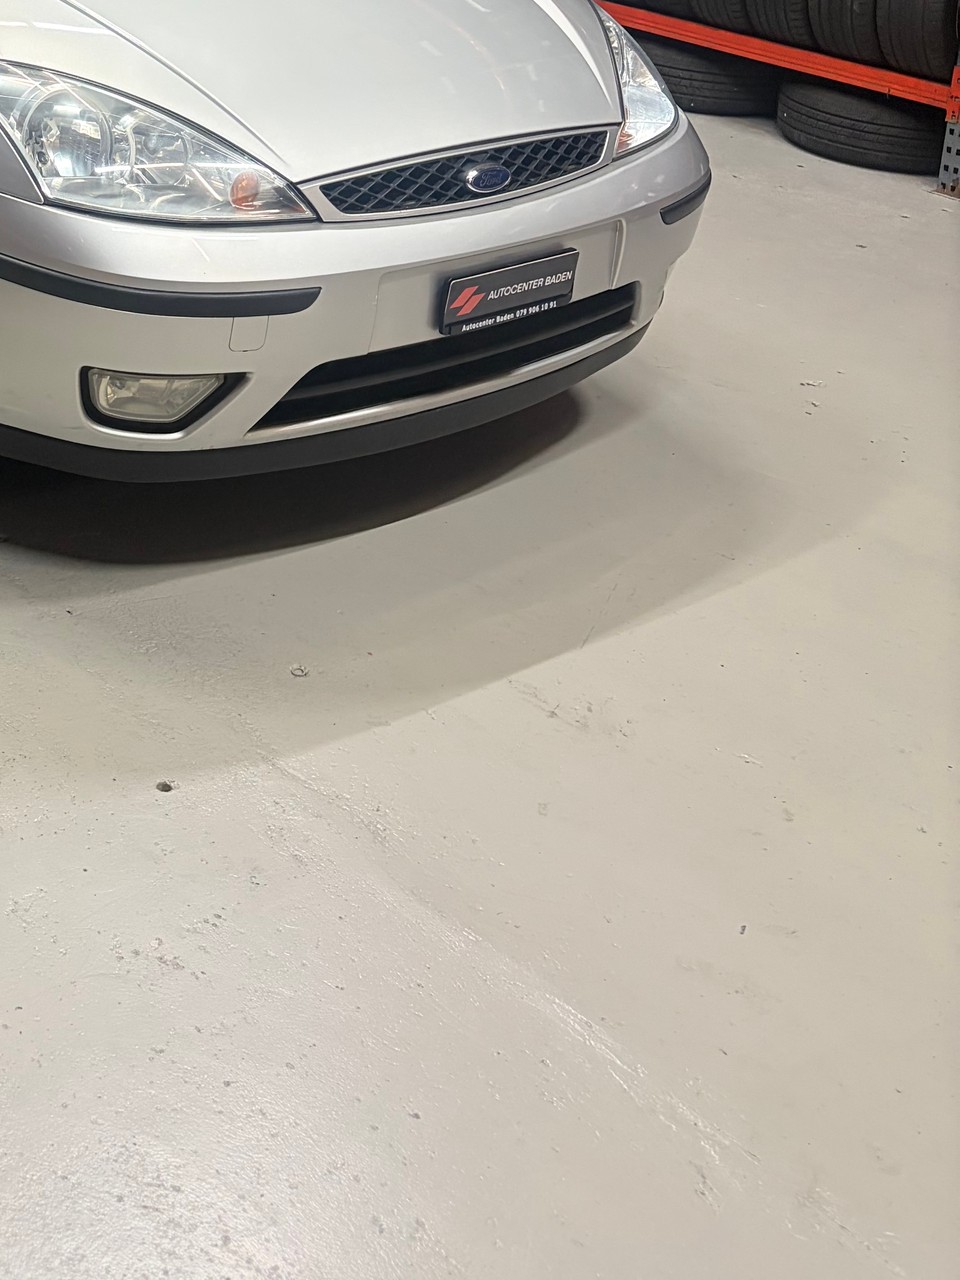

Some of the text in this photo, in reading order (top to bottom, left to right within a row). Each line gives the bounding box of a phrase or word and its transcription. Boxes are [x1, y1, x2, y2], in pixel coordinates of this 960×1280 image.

[487, 270, 573, 301] AUTOCENTER BADEN
[461, 316, 495, 332] Autocenter
[496, 312, 515, 323] Baden
[549, 300, 557, 309] 91
